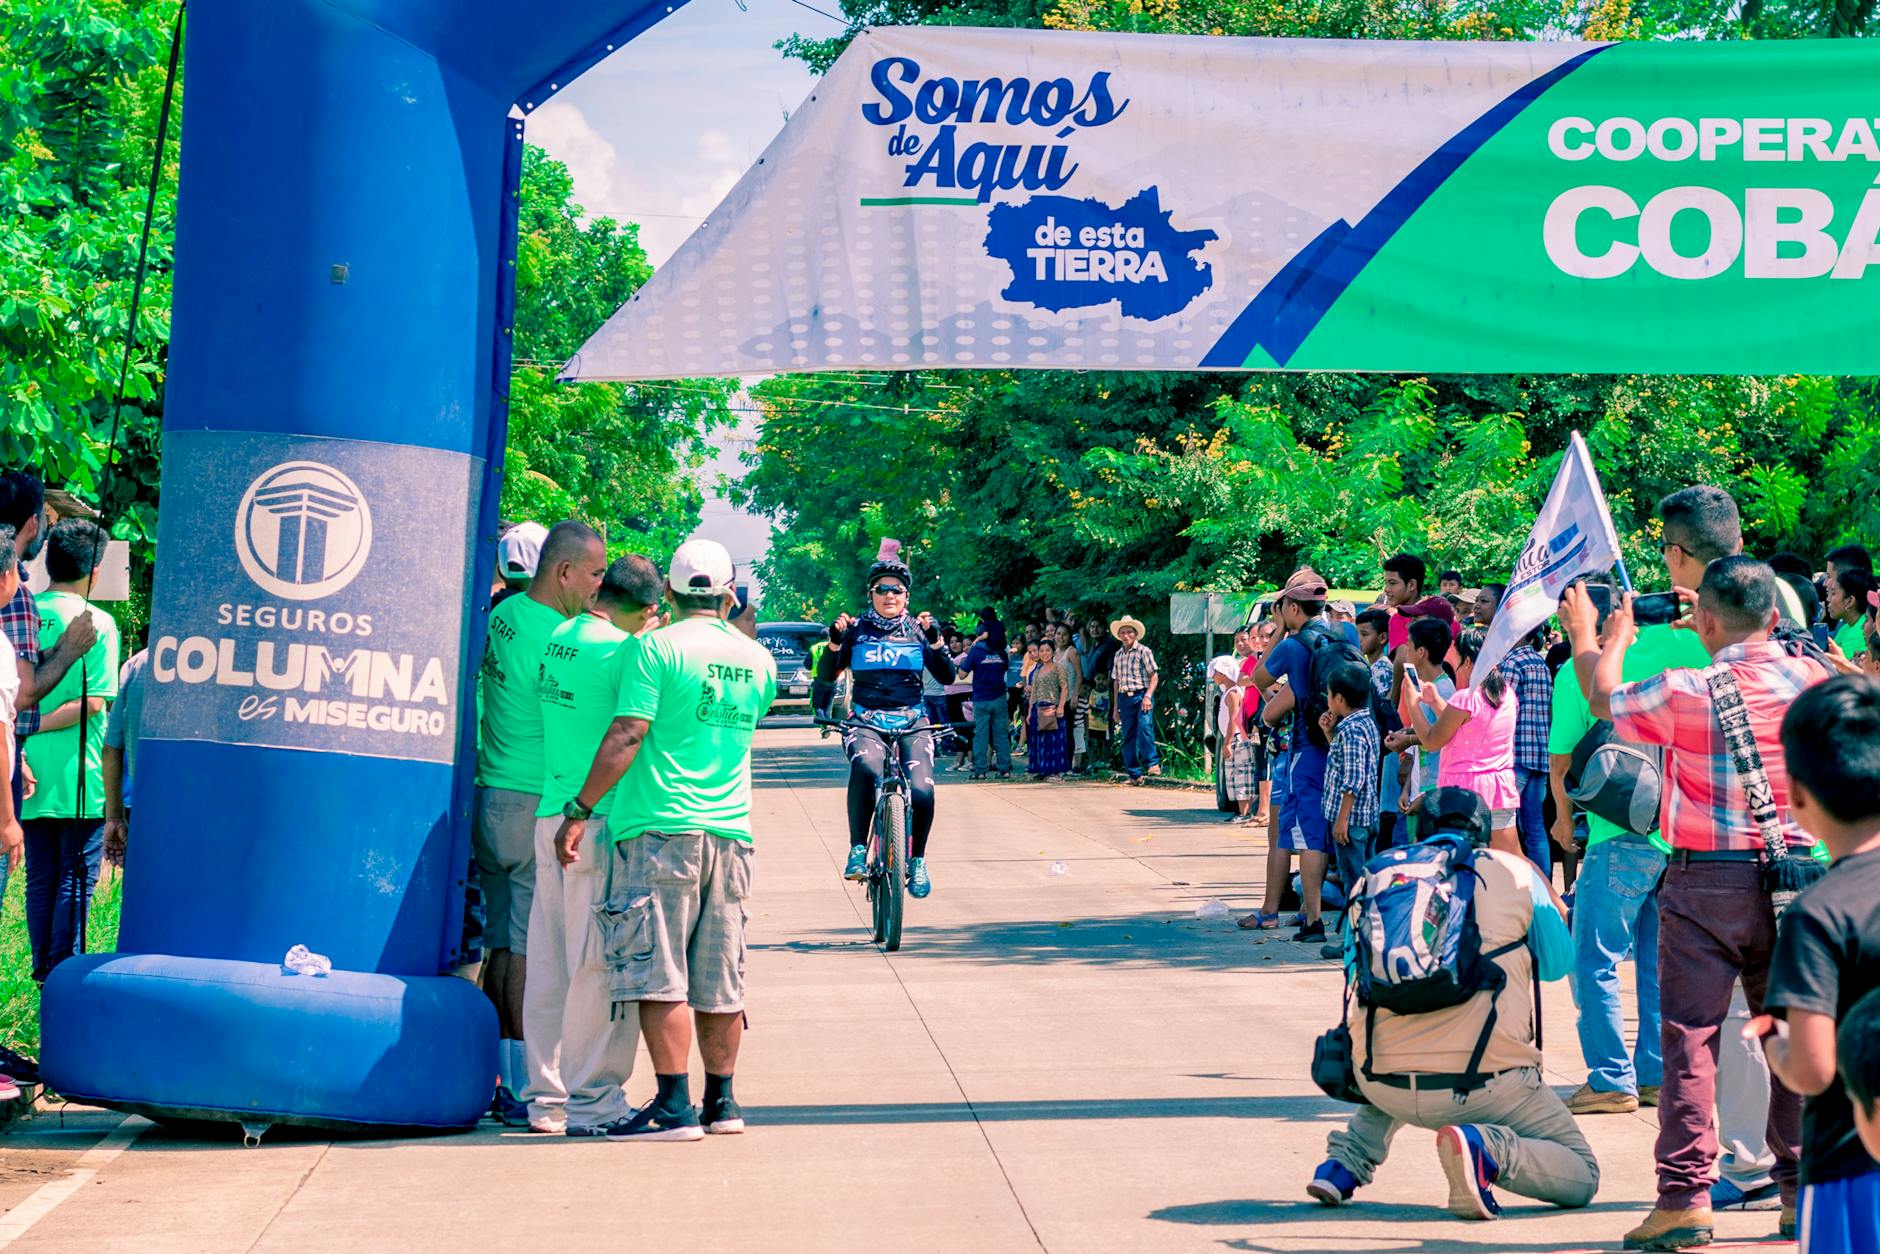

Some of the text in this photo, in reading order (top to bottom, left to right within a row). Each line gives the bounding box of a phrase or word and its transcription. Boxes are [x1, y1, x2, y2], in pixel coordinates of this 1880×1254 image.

[861, 57, 1130, 127] Somos
[1548, 116, 1880, 162] COOPERA
[888, 124, 1079, 203] de Aquí
[1034, 216, 1145, 249] de esta
[1027, 248, 1168, 284] TIERRA
[217, 603, 373, 637] SEGUROS
[491, 615, 516, 644] STAFF
[544, 642, 579, 662] STAFF
[864, 645, 902, 667] sky
[153, 635, 449, 705] COLUMNA
[707, 663, 754, 684] STAFF
[237, 695, 279, 721] es
